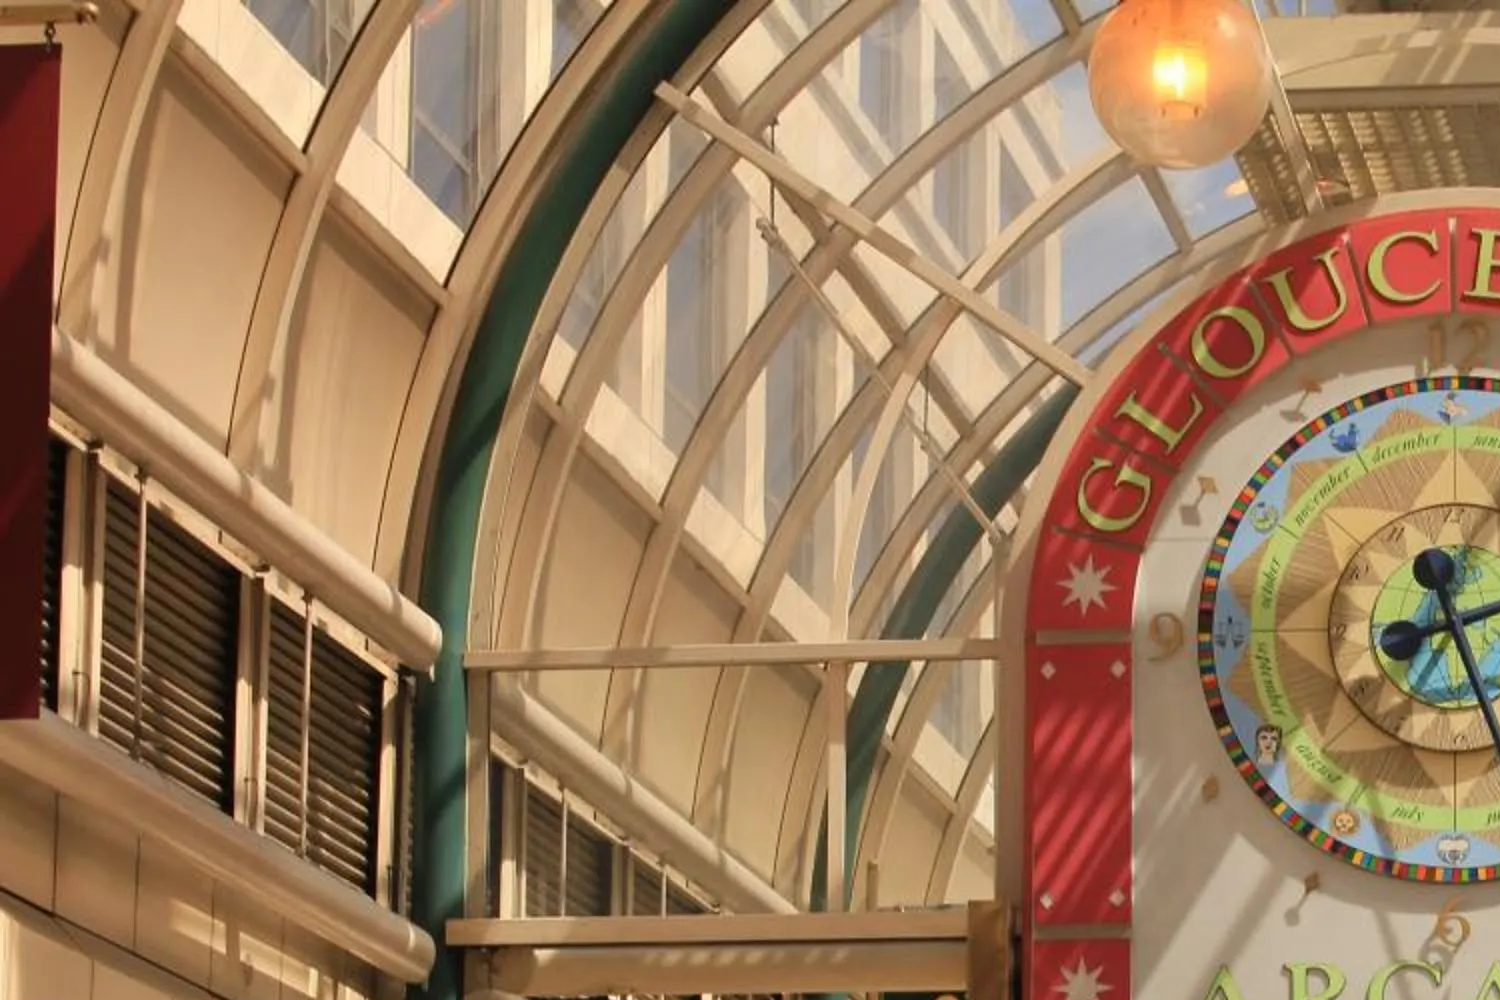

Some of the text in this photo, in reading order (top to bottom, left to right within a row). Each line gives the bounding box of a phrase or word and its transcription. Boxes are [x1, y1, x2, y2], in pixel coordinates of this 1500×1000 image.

[1429, 318, 1491, 372] 12
[1372, 431, 1441, 465] december
[1295, 467, 1351, 527] november
[1148, 611, 1184, 667] 9
[1256, 642, 1286, 718] september
[1296, 744, 1342, 784] august
[1391, 805, 1425, 823] july
[1437, 892, 1471, 954] 6
